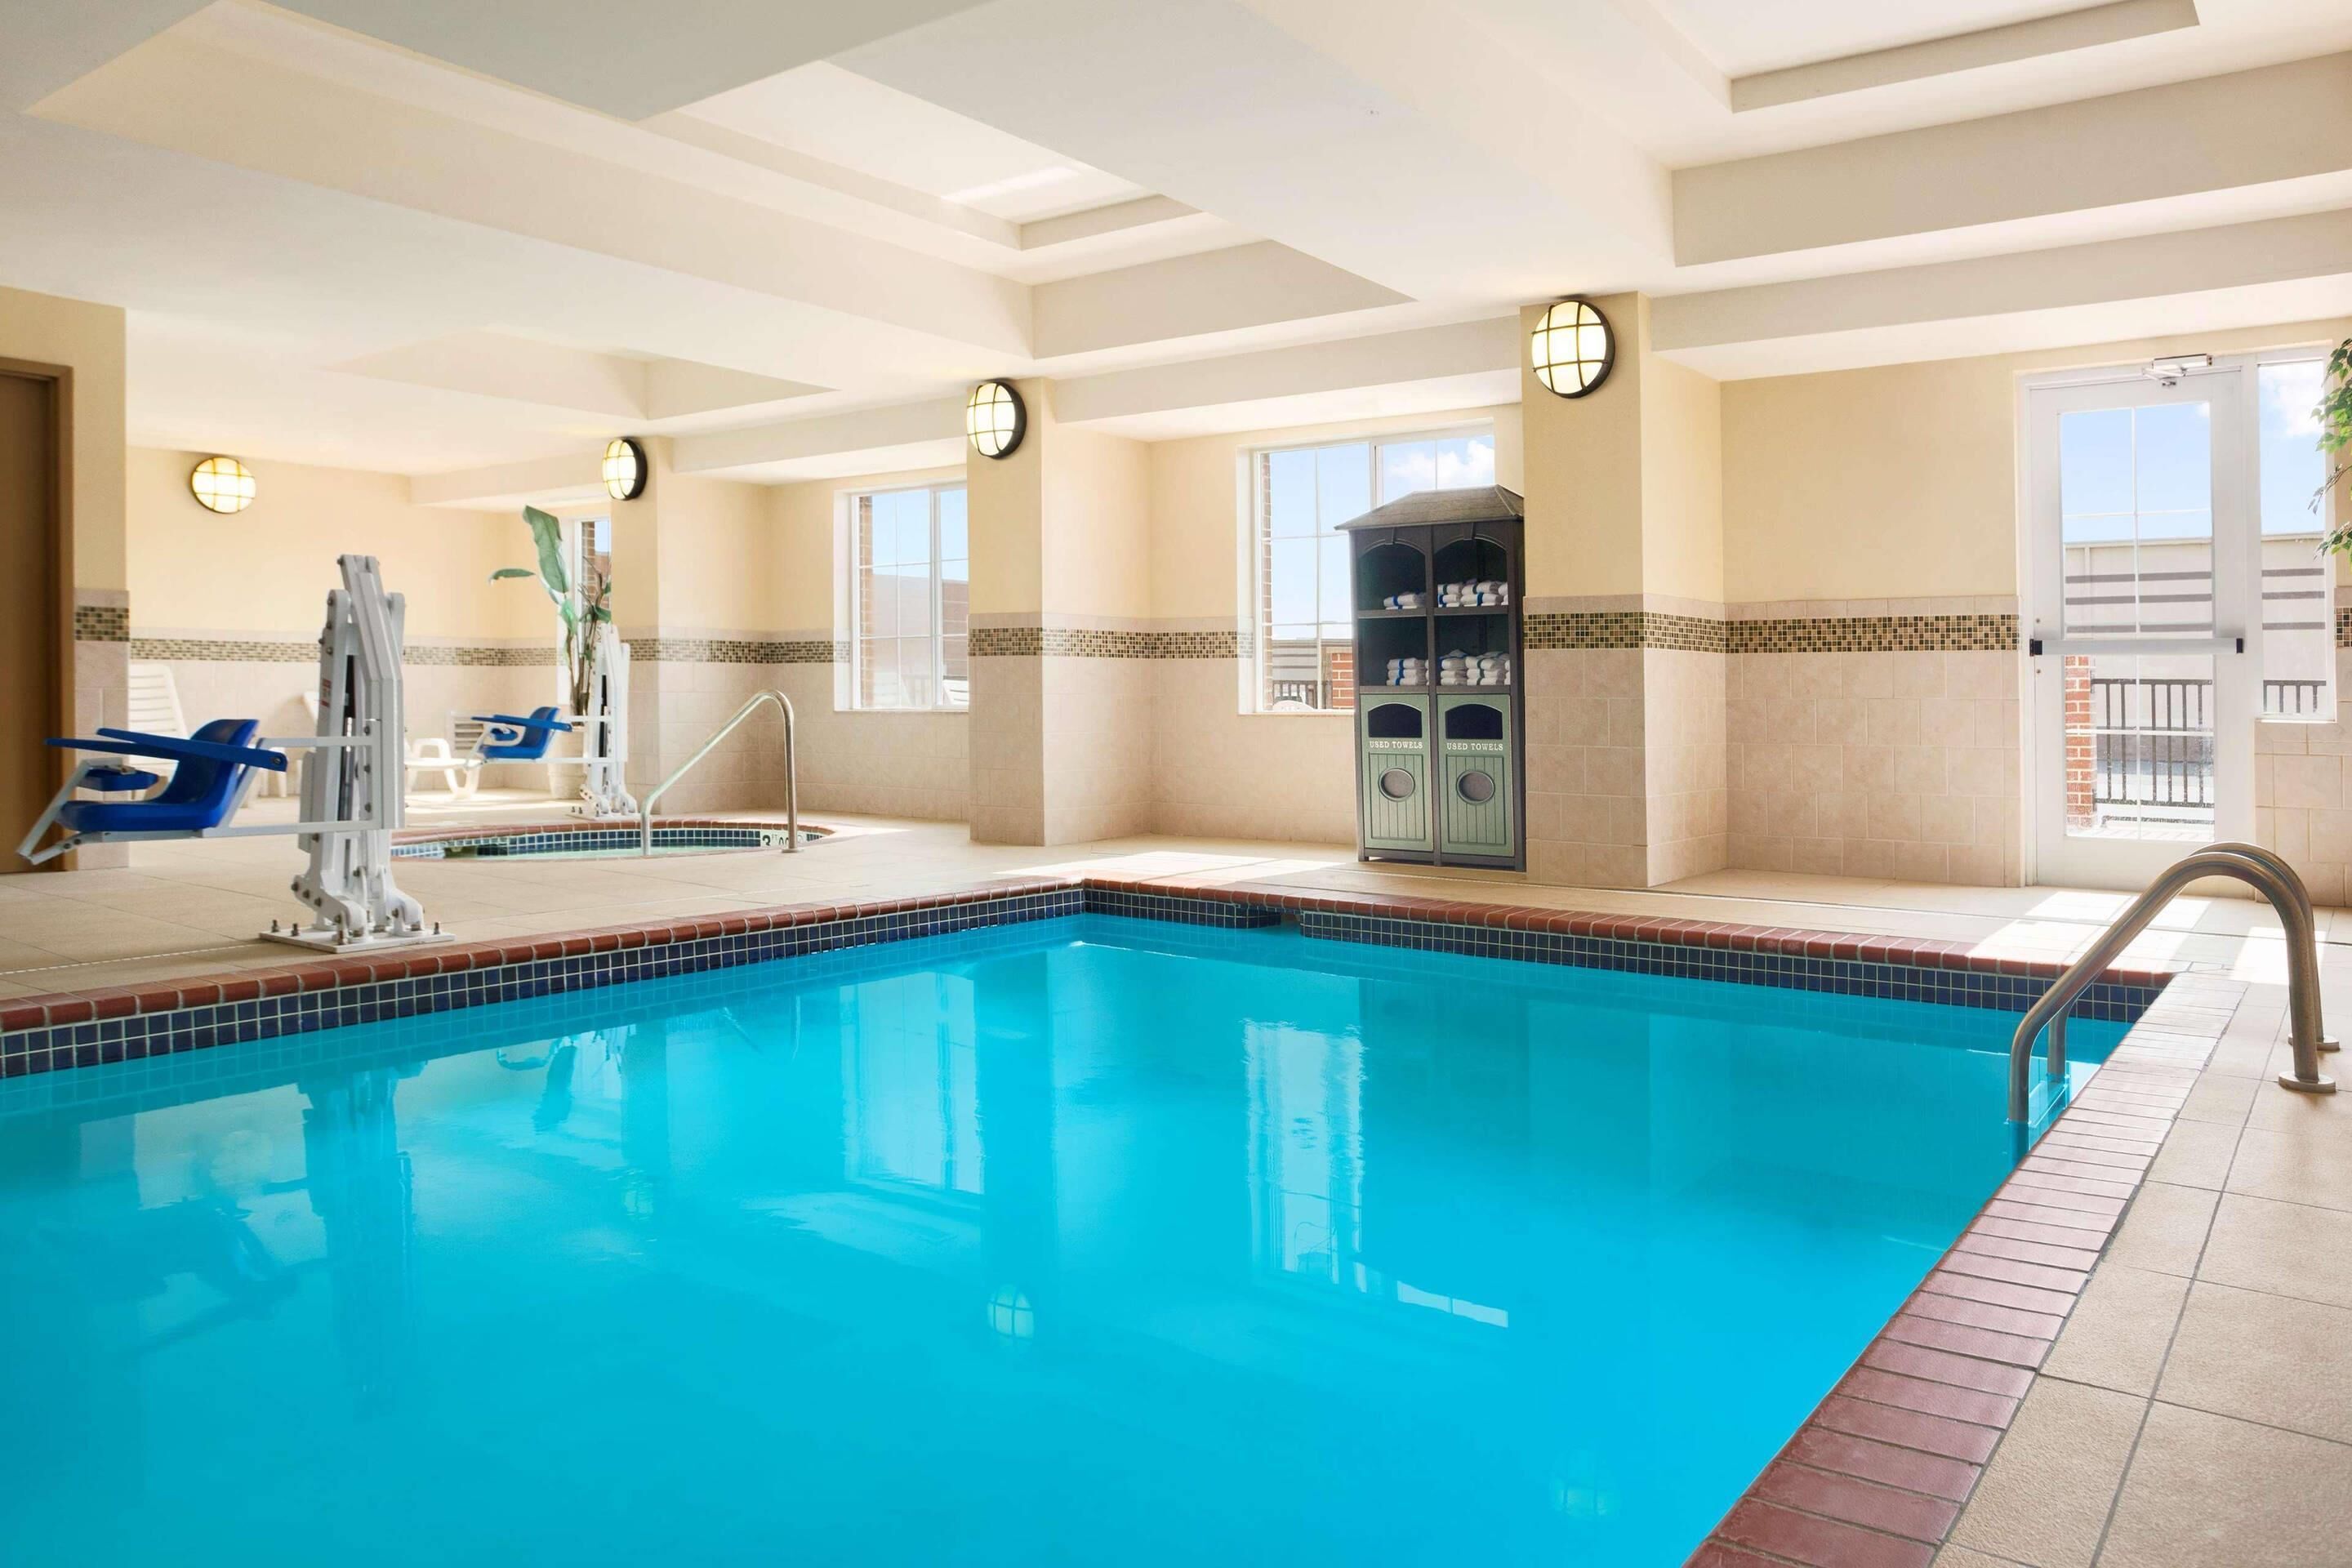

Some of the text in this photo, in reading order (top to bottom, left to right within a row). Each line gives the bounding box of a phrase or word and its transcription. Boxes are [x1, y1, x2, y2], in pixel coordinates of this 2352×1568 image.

[1369, 741, 1423, 749] USED TOWELS
[1446, 742, 1503, 751] USED TOWELS
